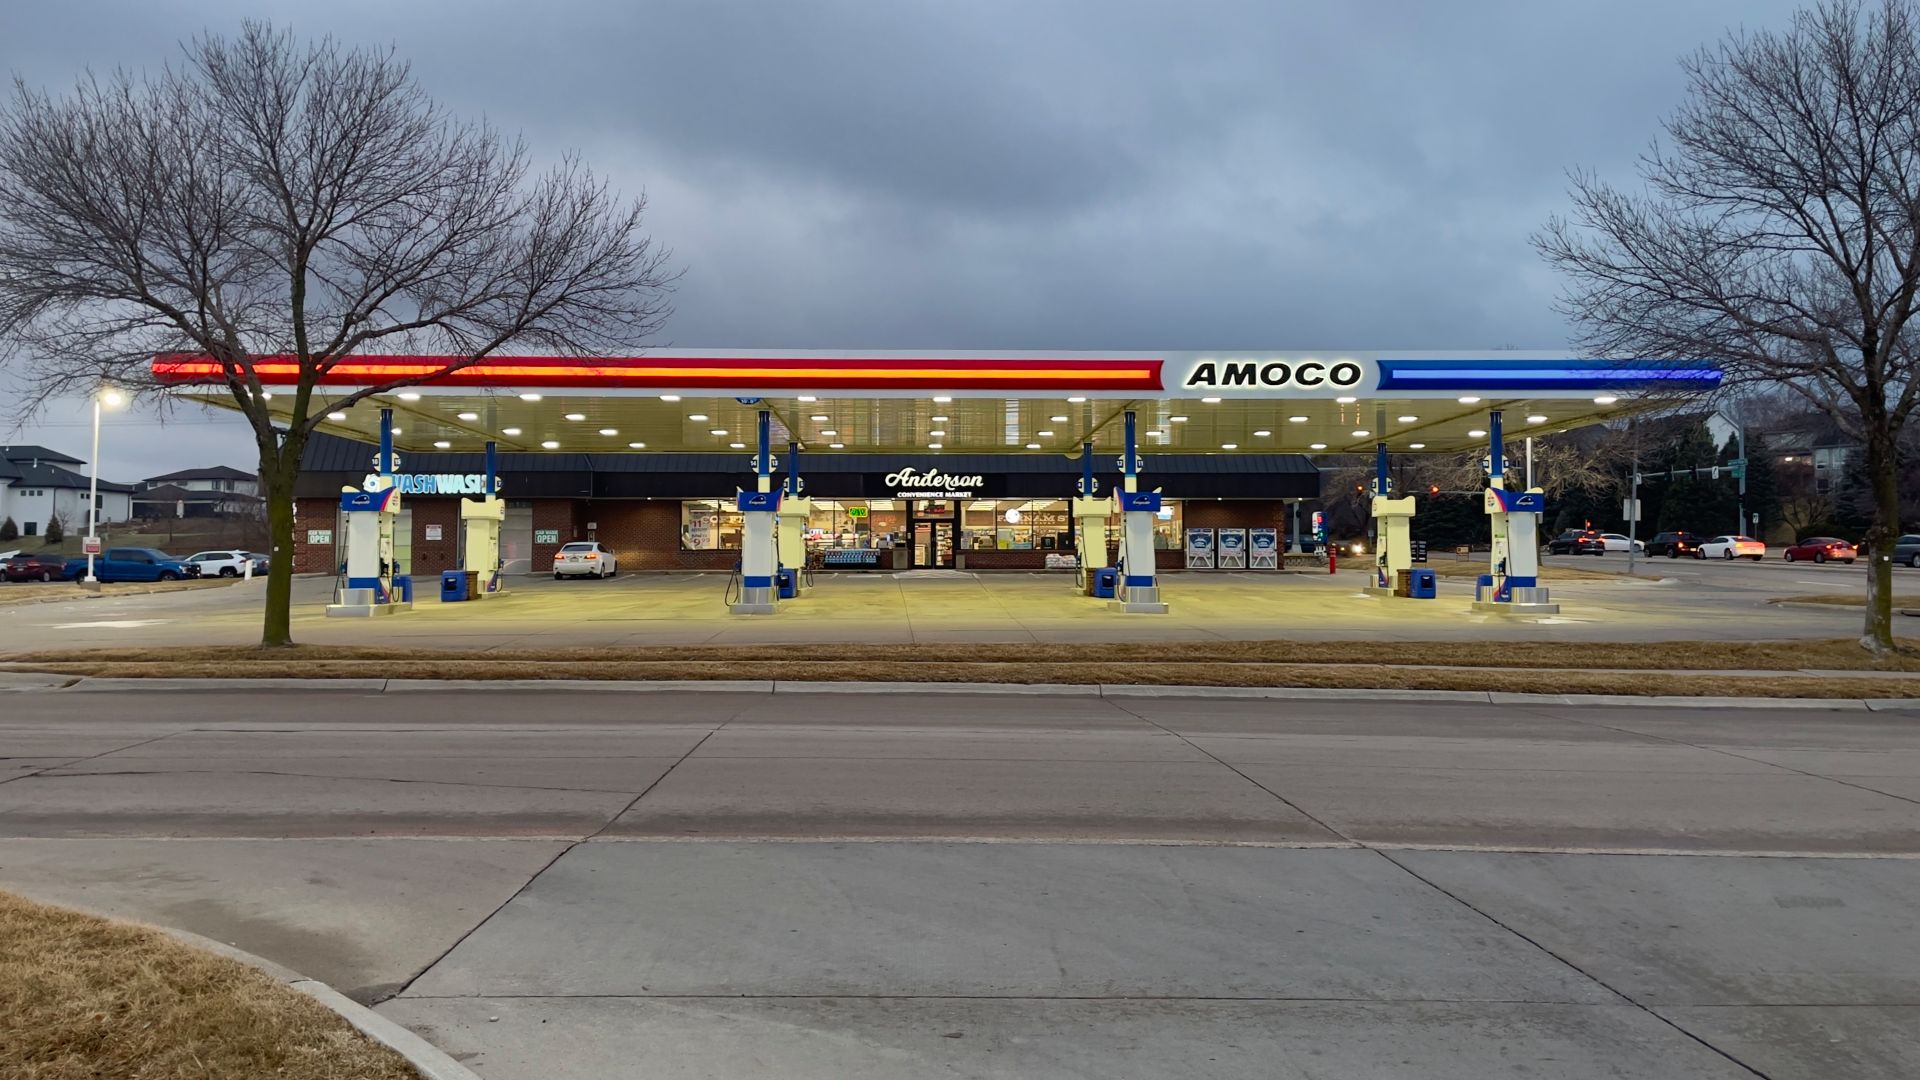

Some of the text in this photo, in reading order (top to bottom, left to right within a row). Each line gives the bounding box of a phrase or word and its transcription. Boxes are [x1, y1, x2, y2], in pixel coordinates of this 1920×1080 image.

[1186, 361, 1362, 386] AMOCO
[885, 467, 984, 491] Anderson
[309, 535, 331, 544] OPEN
[537, 535, 557, 544] OPEN
